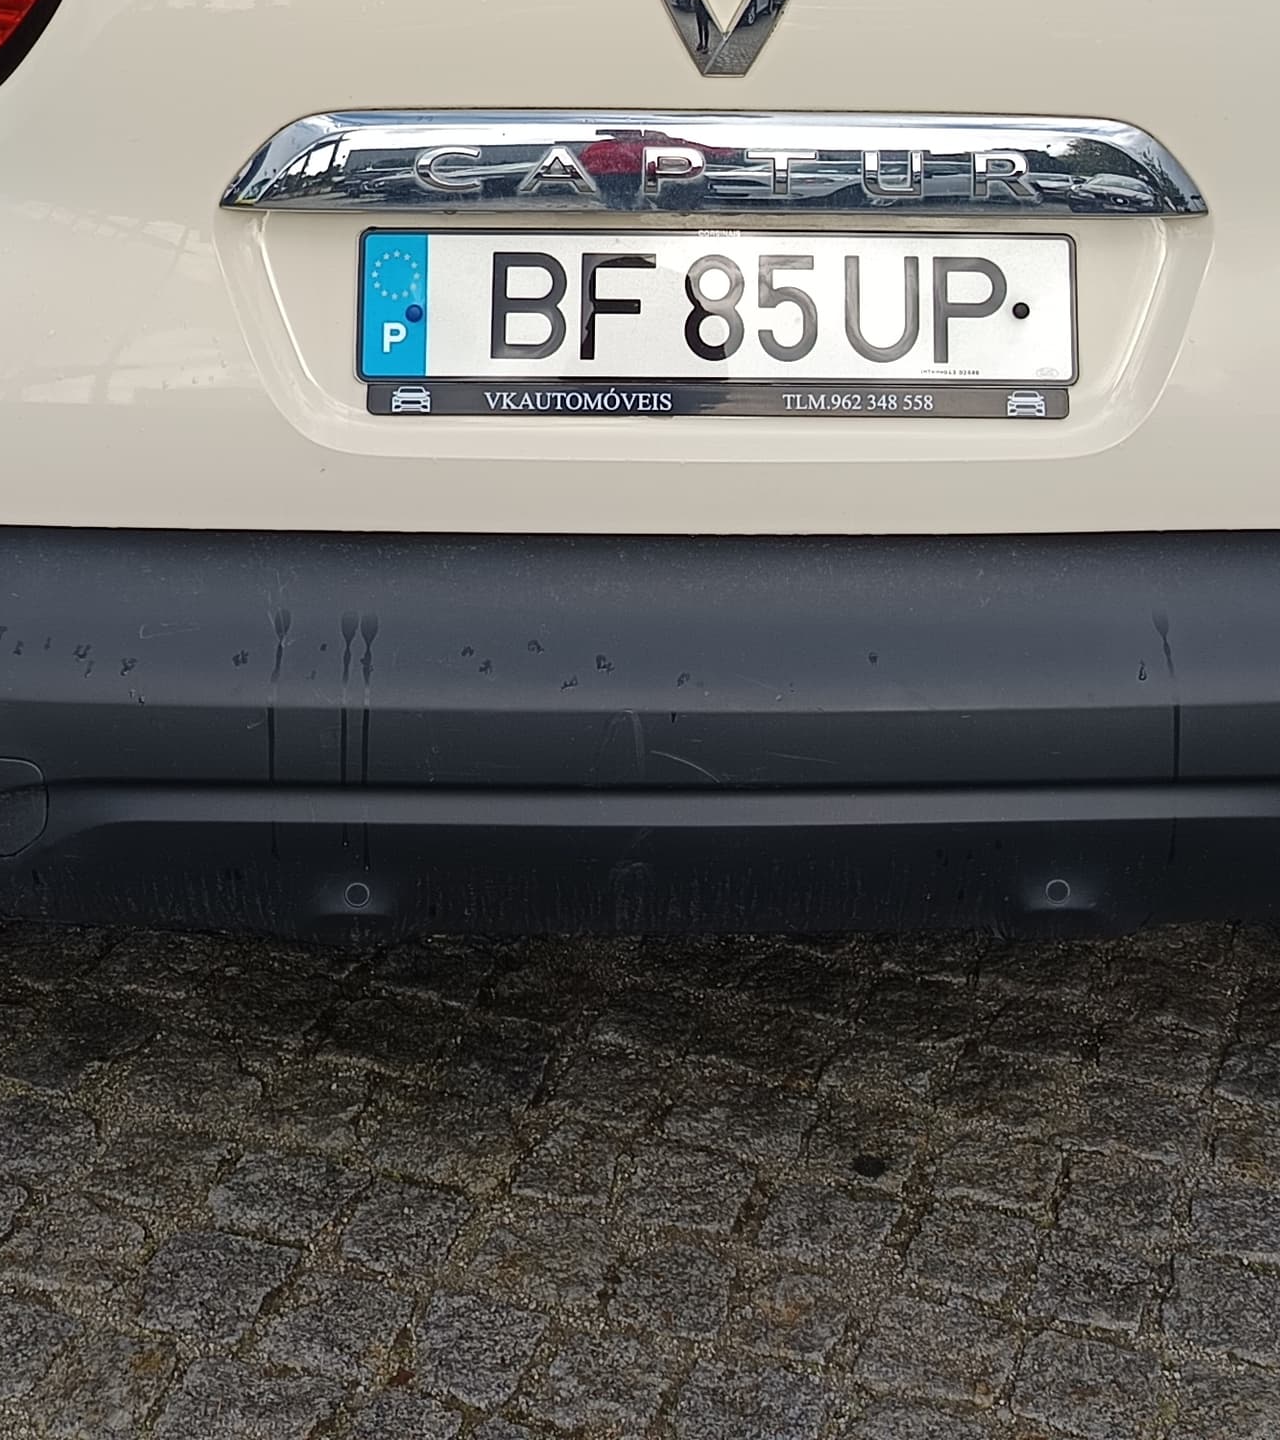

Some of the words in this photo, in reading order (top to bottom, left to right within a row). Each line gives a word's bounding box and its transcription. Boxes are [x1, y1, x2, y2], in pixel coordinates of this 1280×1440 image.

[414, 145, 1034, 198] CAPTUR
[490, 251, 657, 361] BF
[382, 322, 408, 353] P
[483, 388, 673, 411] VKAUTOMÓVEIS
[782, 393, 862, 411] TLM.962
[866, 393, 898, 411] 348
[902, 394, 934, 411] 558
